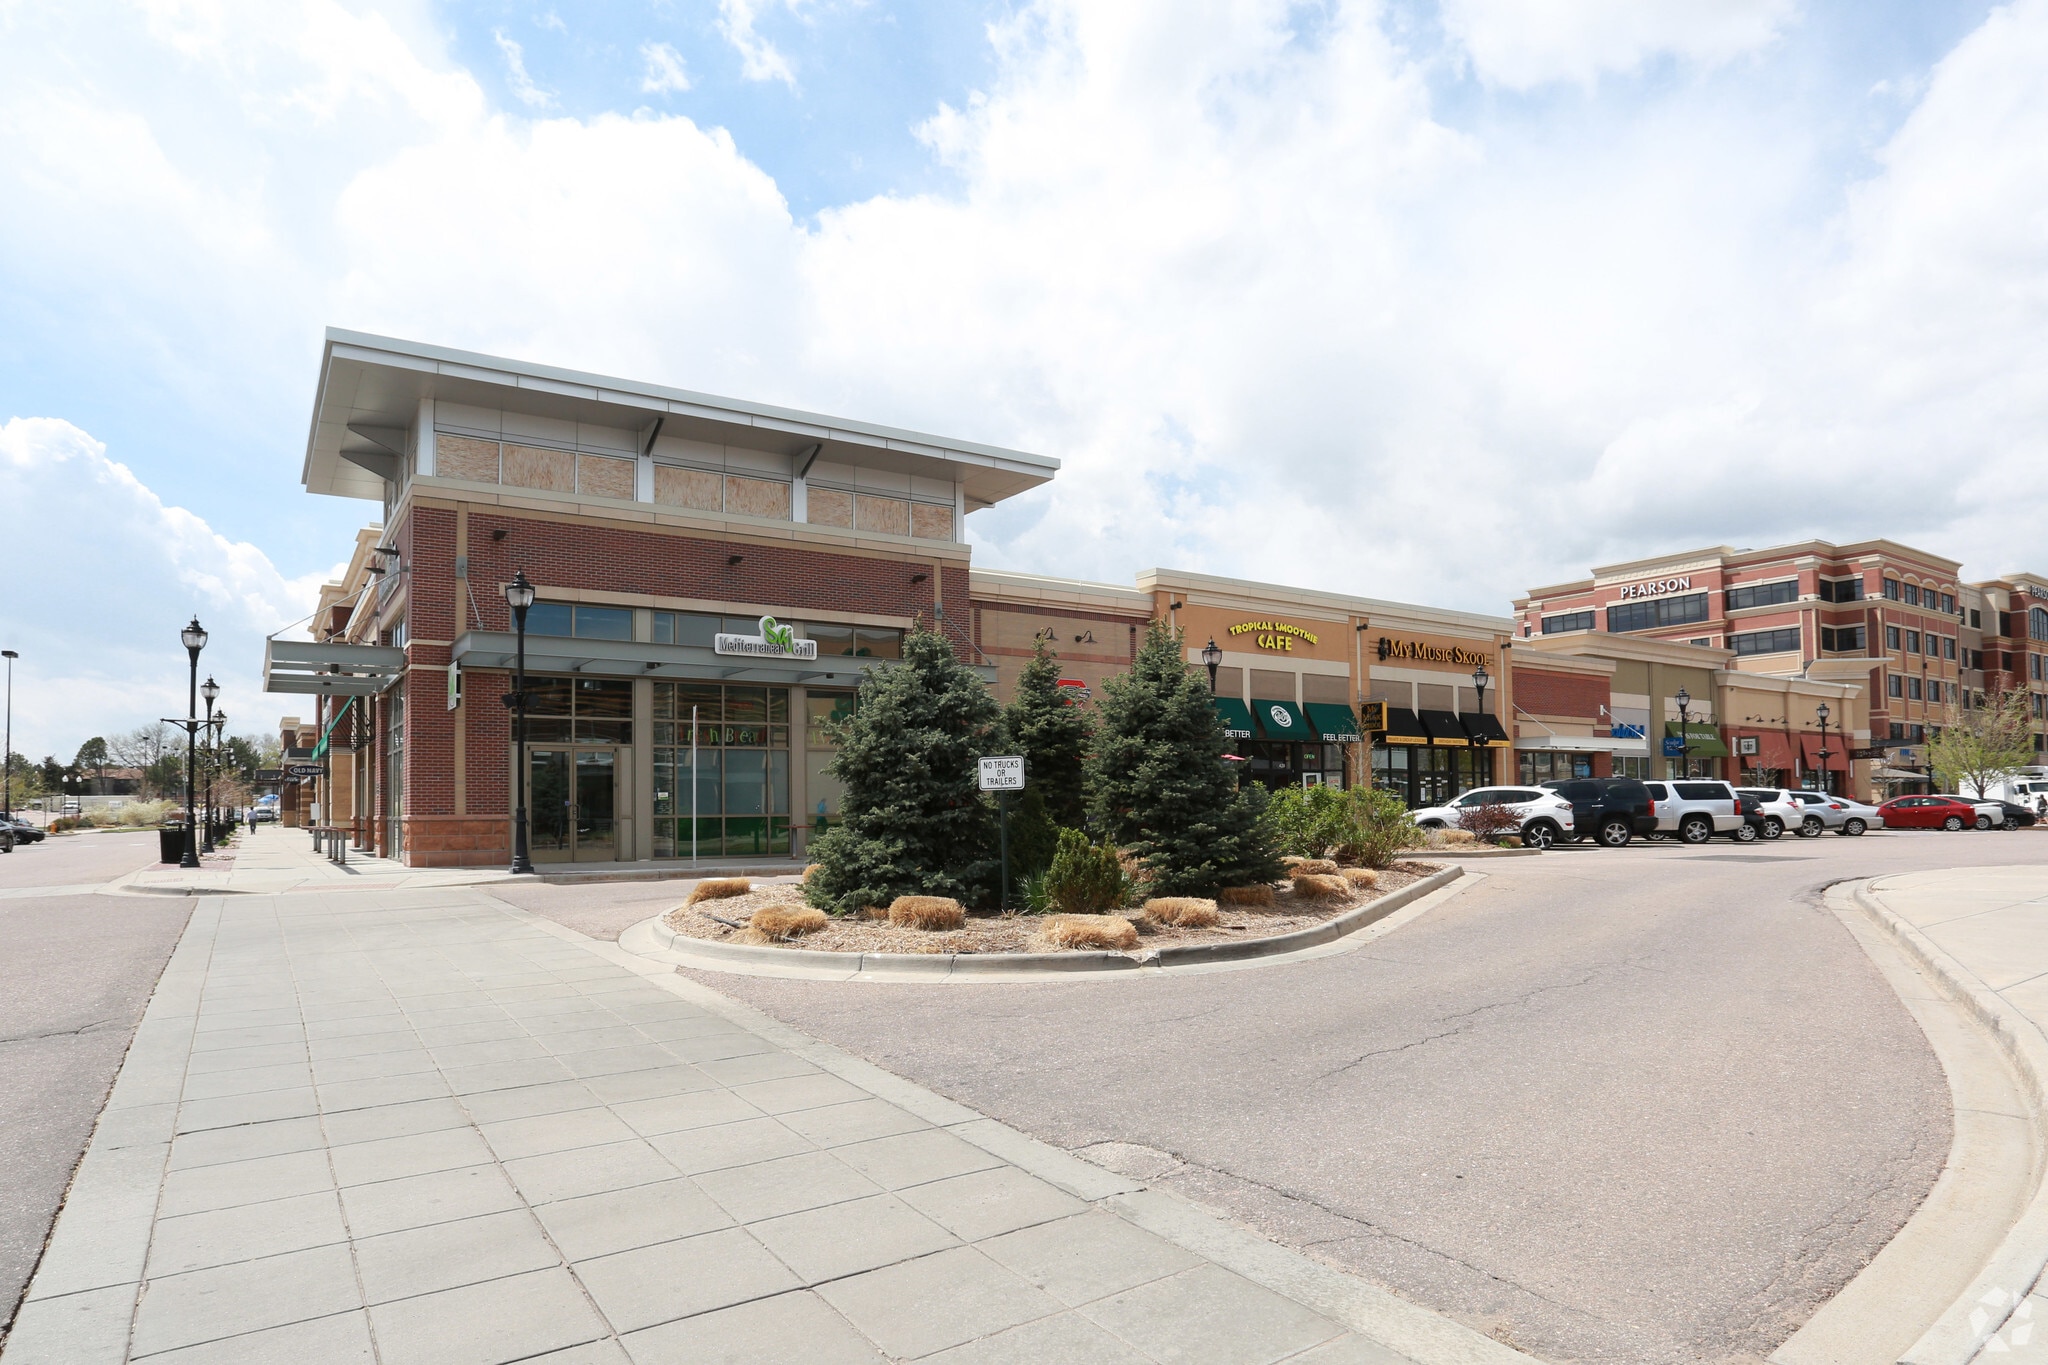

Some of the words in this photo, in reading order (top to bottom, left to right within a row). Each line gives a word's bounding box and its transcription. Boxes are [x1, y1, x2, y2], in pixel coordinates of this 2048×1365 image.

[1620, 576, 1691, 599] PEARSON
[1229, 621, 1273, 636] TROPICAL
[1274, 622, 1318, 645] SMOOTHIE
[719, 636, 785, 655] Mediterranean
[792, 641, 815, 656] Grill
[1257, 633, 1292, 651] CAFE
[1322, 733, 1338, 741] FEEL
[983, 761, 993, 770] NO
[994, 760, 1019, 769] TRUCKS
[996, 769, 1006, 777] OR
[986, 776, 1017, 786] TRAILERS
